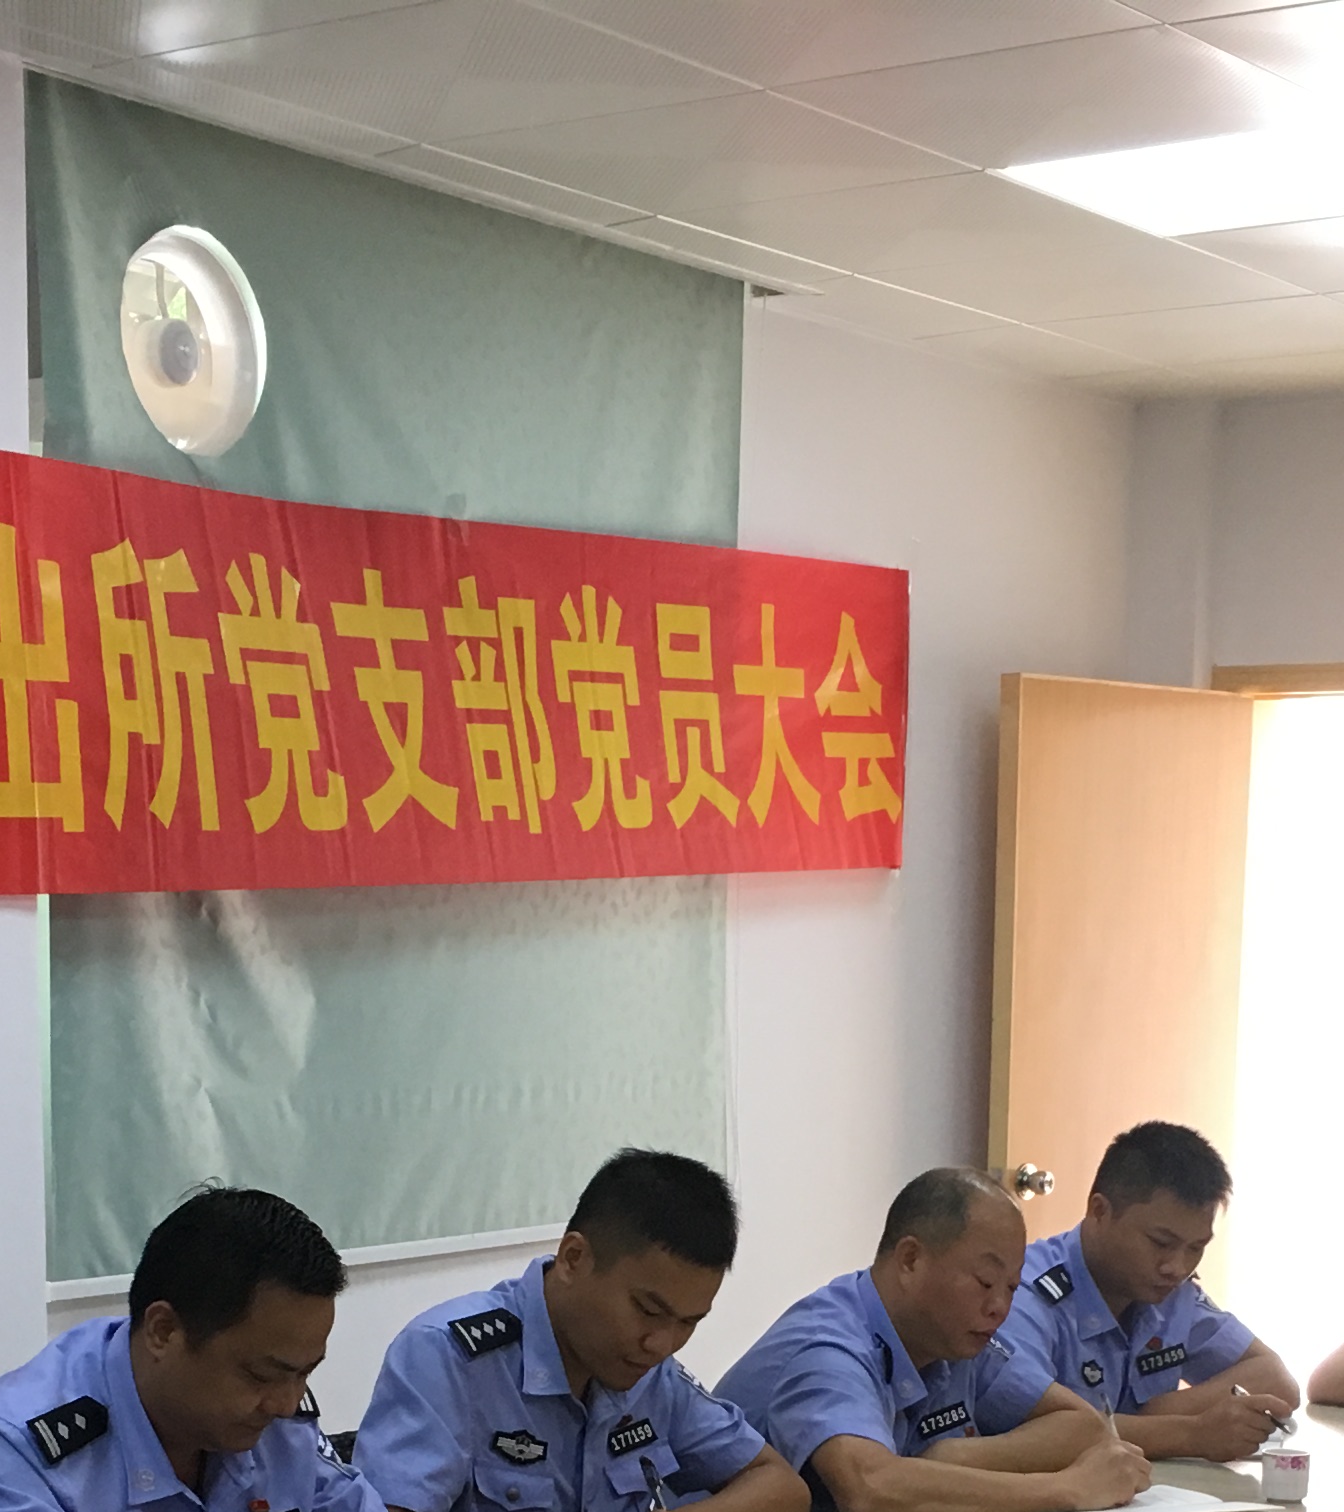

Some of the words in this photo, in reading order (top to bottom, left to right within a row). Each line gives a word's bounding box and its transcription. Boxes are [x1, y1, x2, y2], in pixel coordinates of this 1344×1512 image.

[1141, 1348, 1185, 1371] 173459
[921, 1406, 966, 1434] 173285
[611, 1423, 653, 1451] 177159
